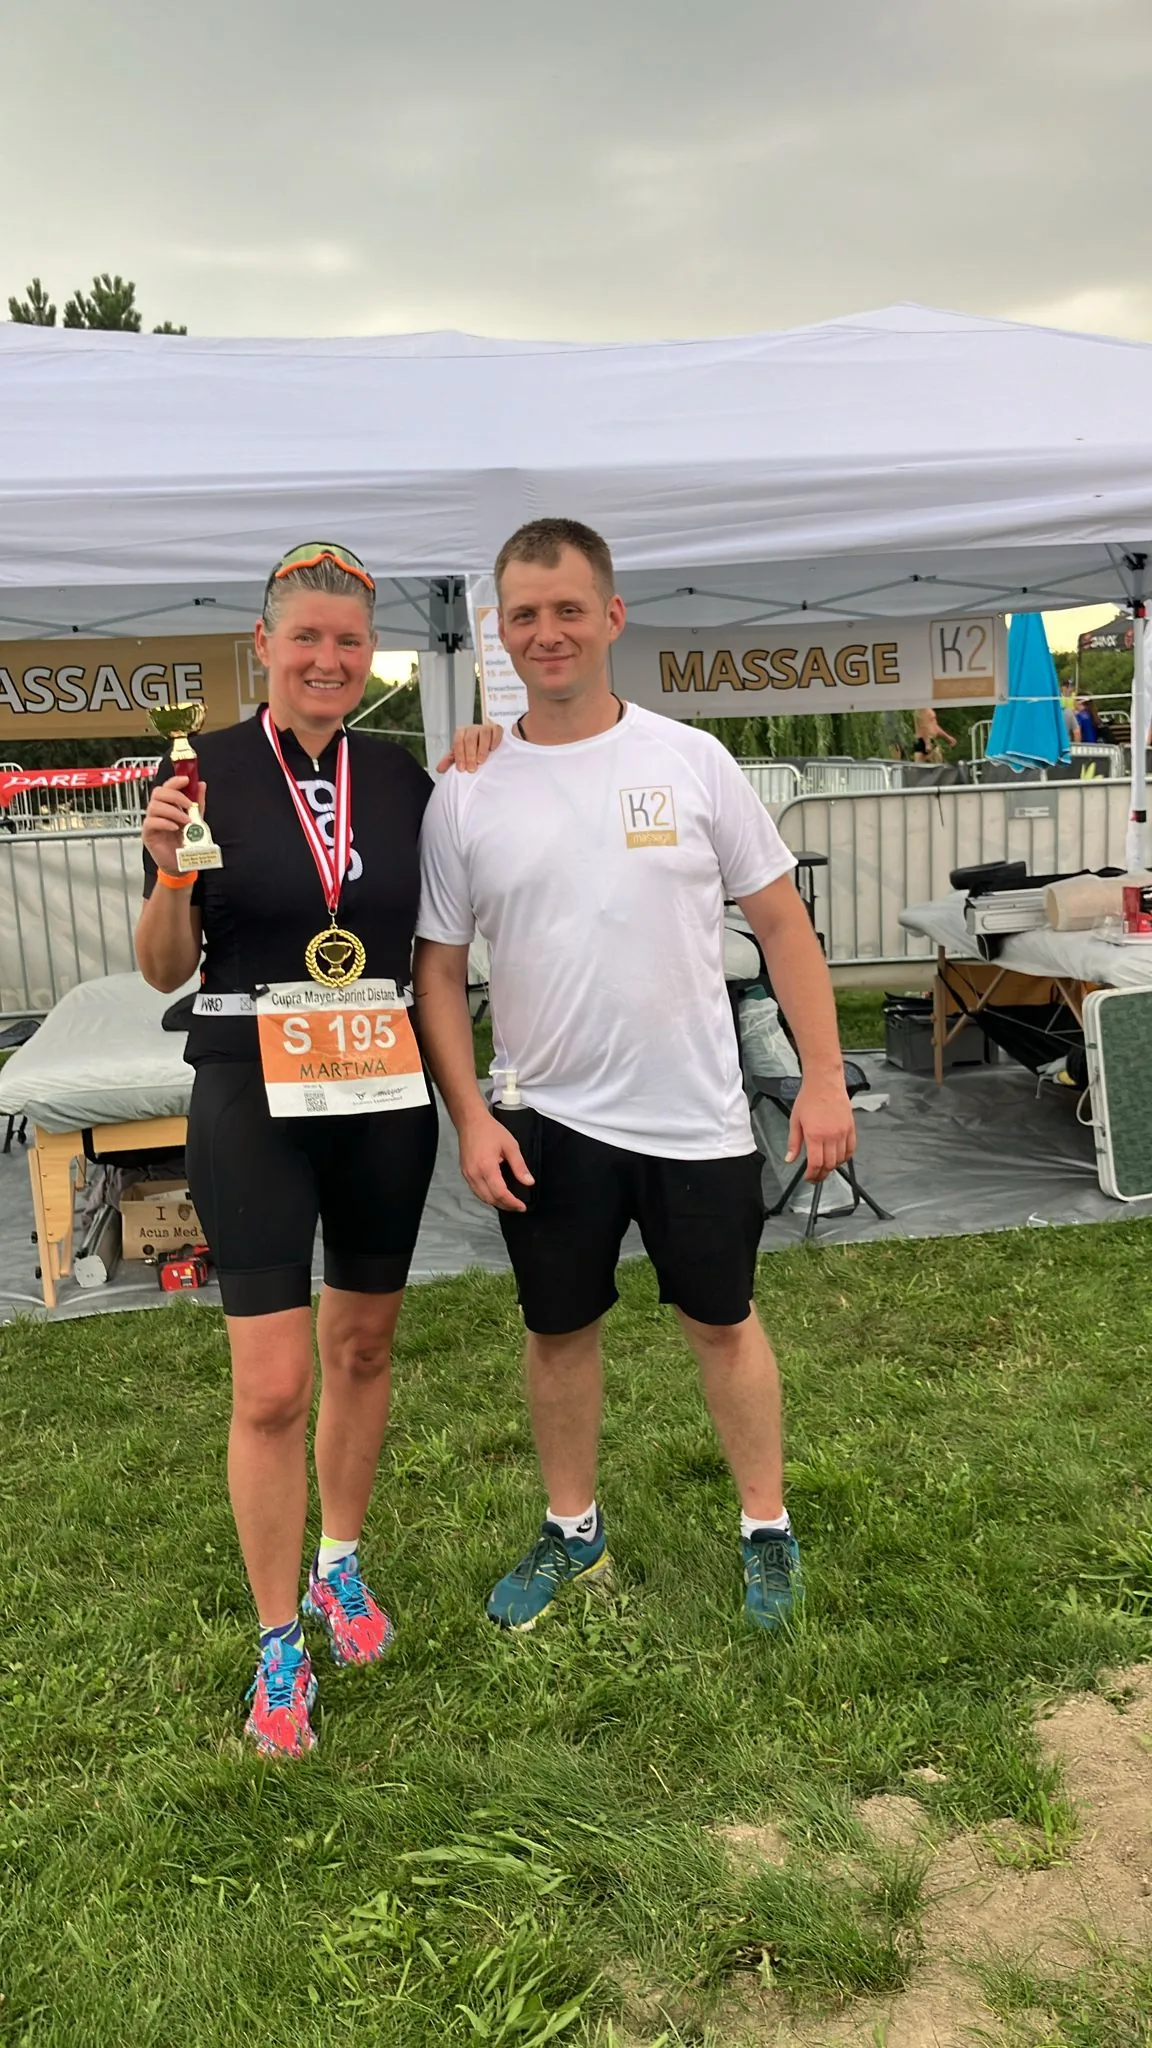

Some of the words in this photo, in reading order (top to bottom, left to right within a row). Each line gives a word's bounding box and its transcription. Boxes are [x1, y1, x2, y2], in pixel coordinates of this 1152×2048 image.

[659, 642, 900, 692] MASSAGE
[940, 625, 987, 673] K2
[628, 791, 670, 828] K2
[271, 992, 302, 1008] Cupra
[304, 990, 335, 1005] Mayer
[338, 988, 366, 1005] Sprint
[282, 1016, 312, 1055] S
[328, 1014, 397, 1053] 195
[300, 1059, 388, 1080] MARTINA
[155, 1206, 166, 1221] I
